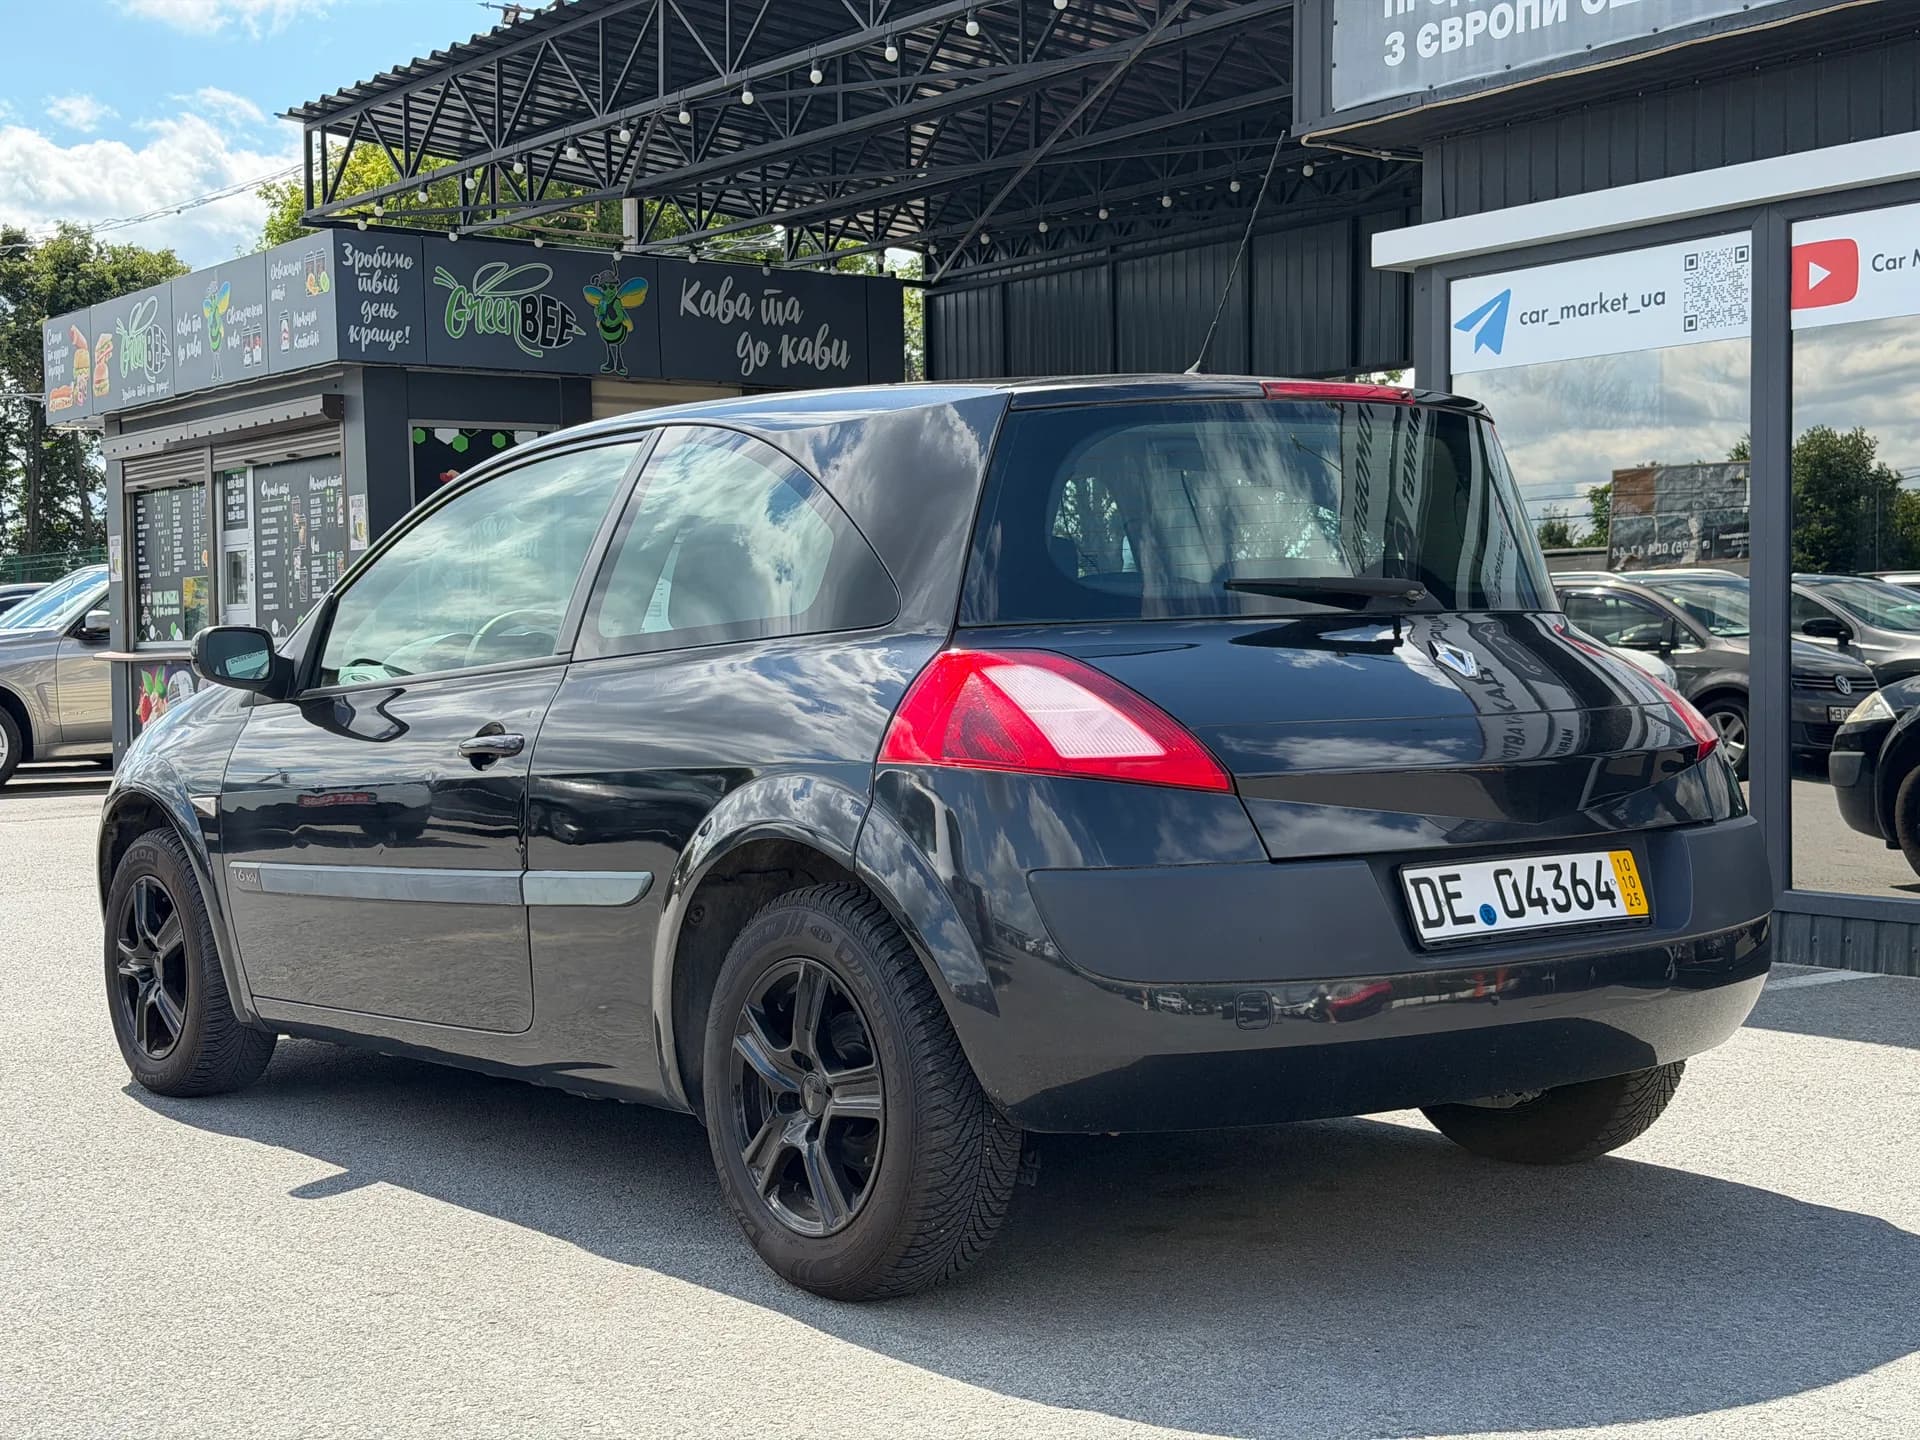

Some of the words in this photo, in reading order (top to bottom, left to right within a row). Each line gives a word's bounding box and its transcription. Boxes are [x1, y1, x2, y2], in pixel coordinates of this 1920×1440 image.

[1384, 31, 1406, 66] З
[1416, 0, 1567, 58] ЄВРОПИ
[342, 243, 414, 275] Зробимо
[1872, 253, 1906, 272] Car
[357, 269, 400, 294] твій
[360, 300, 399, 324] день
[679, 275, 755, 325] Кава
[761, 288, 804, 326] та
[1519, 291, 1666, 326] car_market_ua
[348, 325, 411, 352] краще!
[736, 331, 771, 377] до
[777, 323, 851, 371] кави
[1616, 857, 1631, 873] 10
[1409, 874, 1476, 929] DE
[1493, 860, 1617, 919] 04364
[1621, 875, 1636, 889] 10
[1626, 892, 1641, 907] 25
